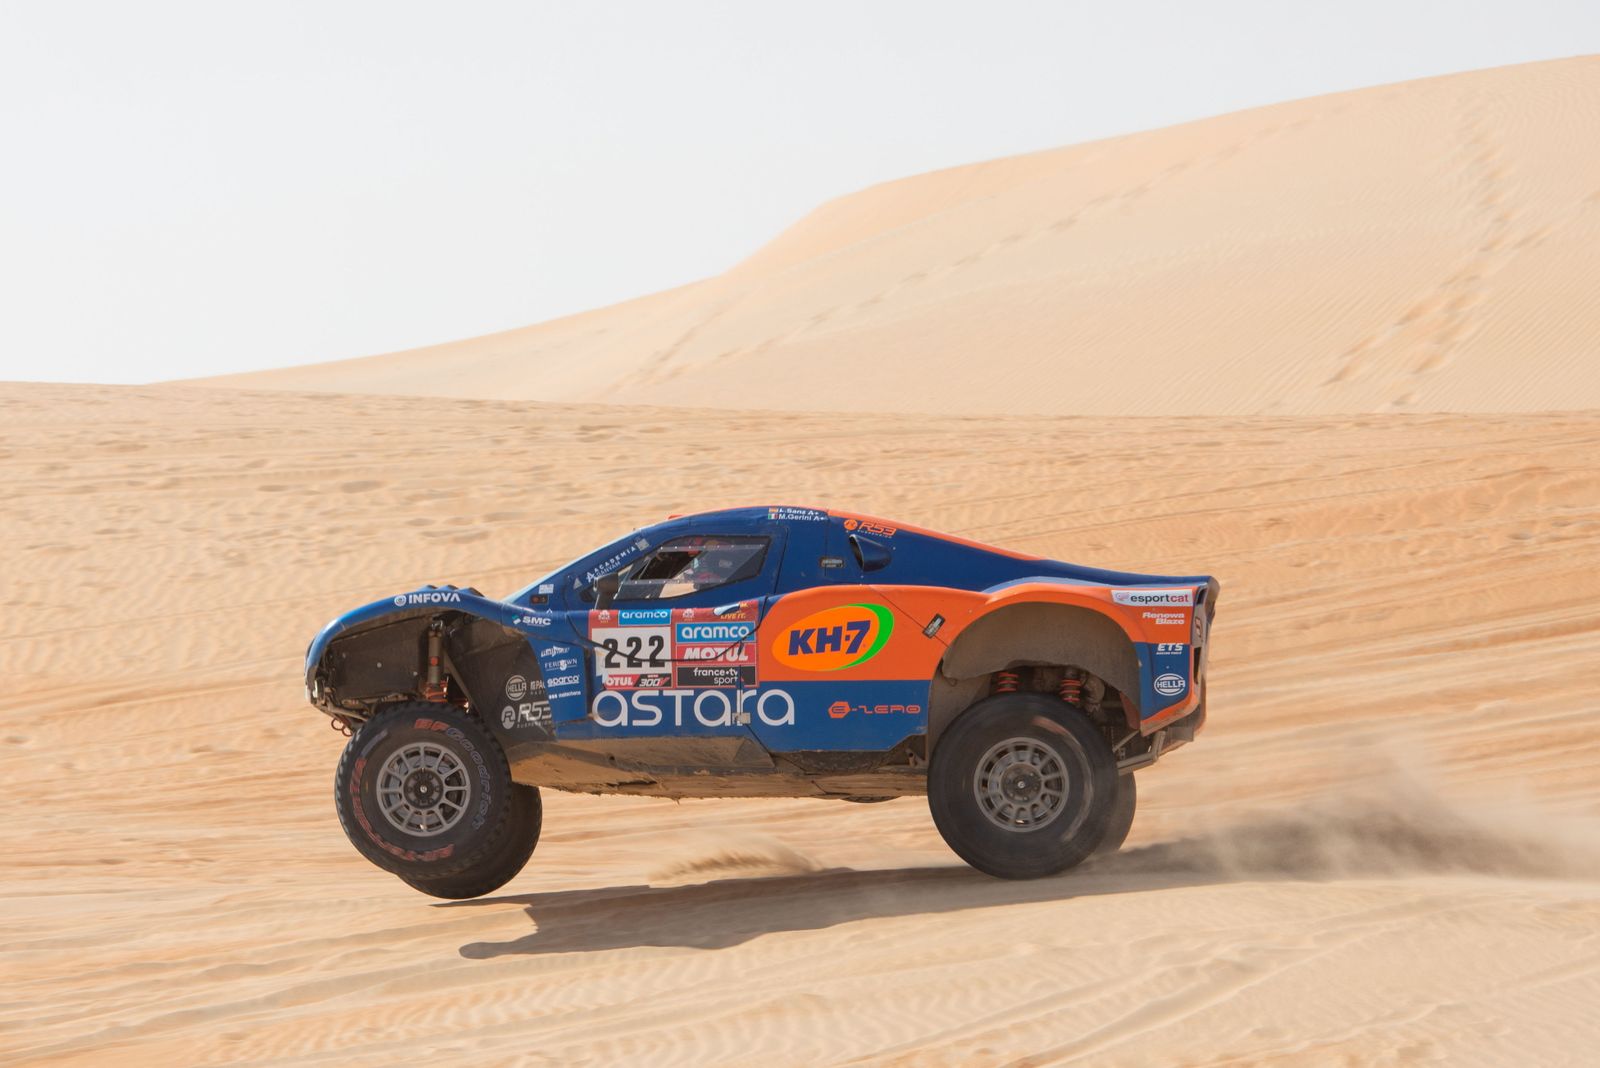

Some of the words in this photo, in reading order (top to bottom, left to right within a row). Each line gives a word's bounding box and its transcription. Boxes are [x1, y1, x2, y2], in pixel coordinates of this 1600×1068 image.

[778, 513, 812, 521] M.Gerini
[594, 546, 636, 573] ACADEMIA
[408, 592, 461, 604] INFOVA
[1130, 593, 1189, 605] esportcat
[622, 610, 668, 619] aramco
[522, 616, 552, 626] SMC
[681, 626, 750, 639] aramco
[788, 620, 871, 656] KH-7
[603, 635, 666, 669] 222
[1157, 642, 1184, 652] ETS
[684, 647, 749, 661] MOTUL
[508, 682, 527, 692] HELLA
[547, 675, 580, 687] sparco
[605, 676, 633, 687] OTUL
[714, 676, 739, 687] sport
[1157, 680, 1186, 689] HELLA
[592, 689, 795, 727] astara
